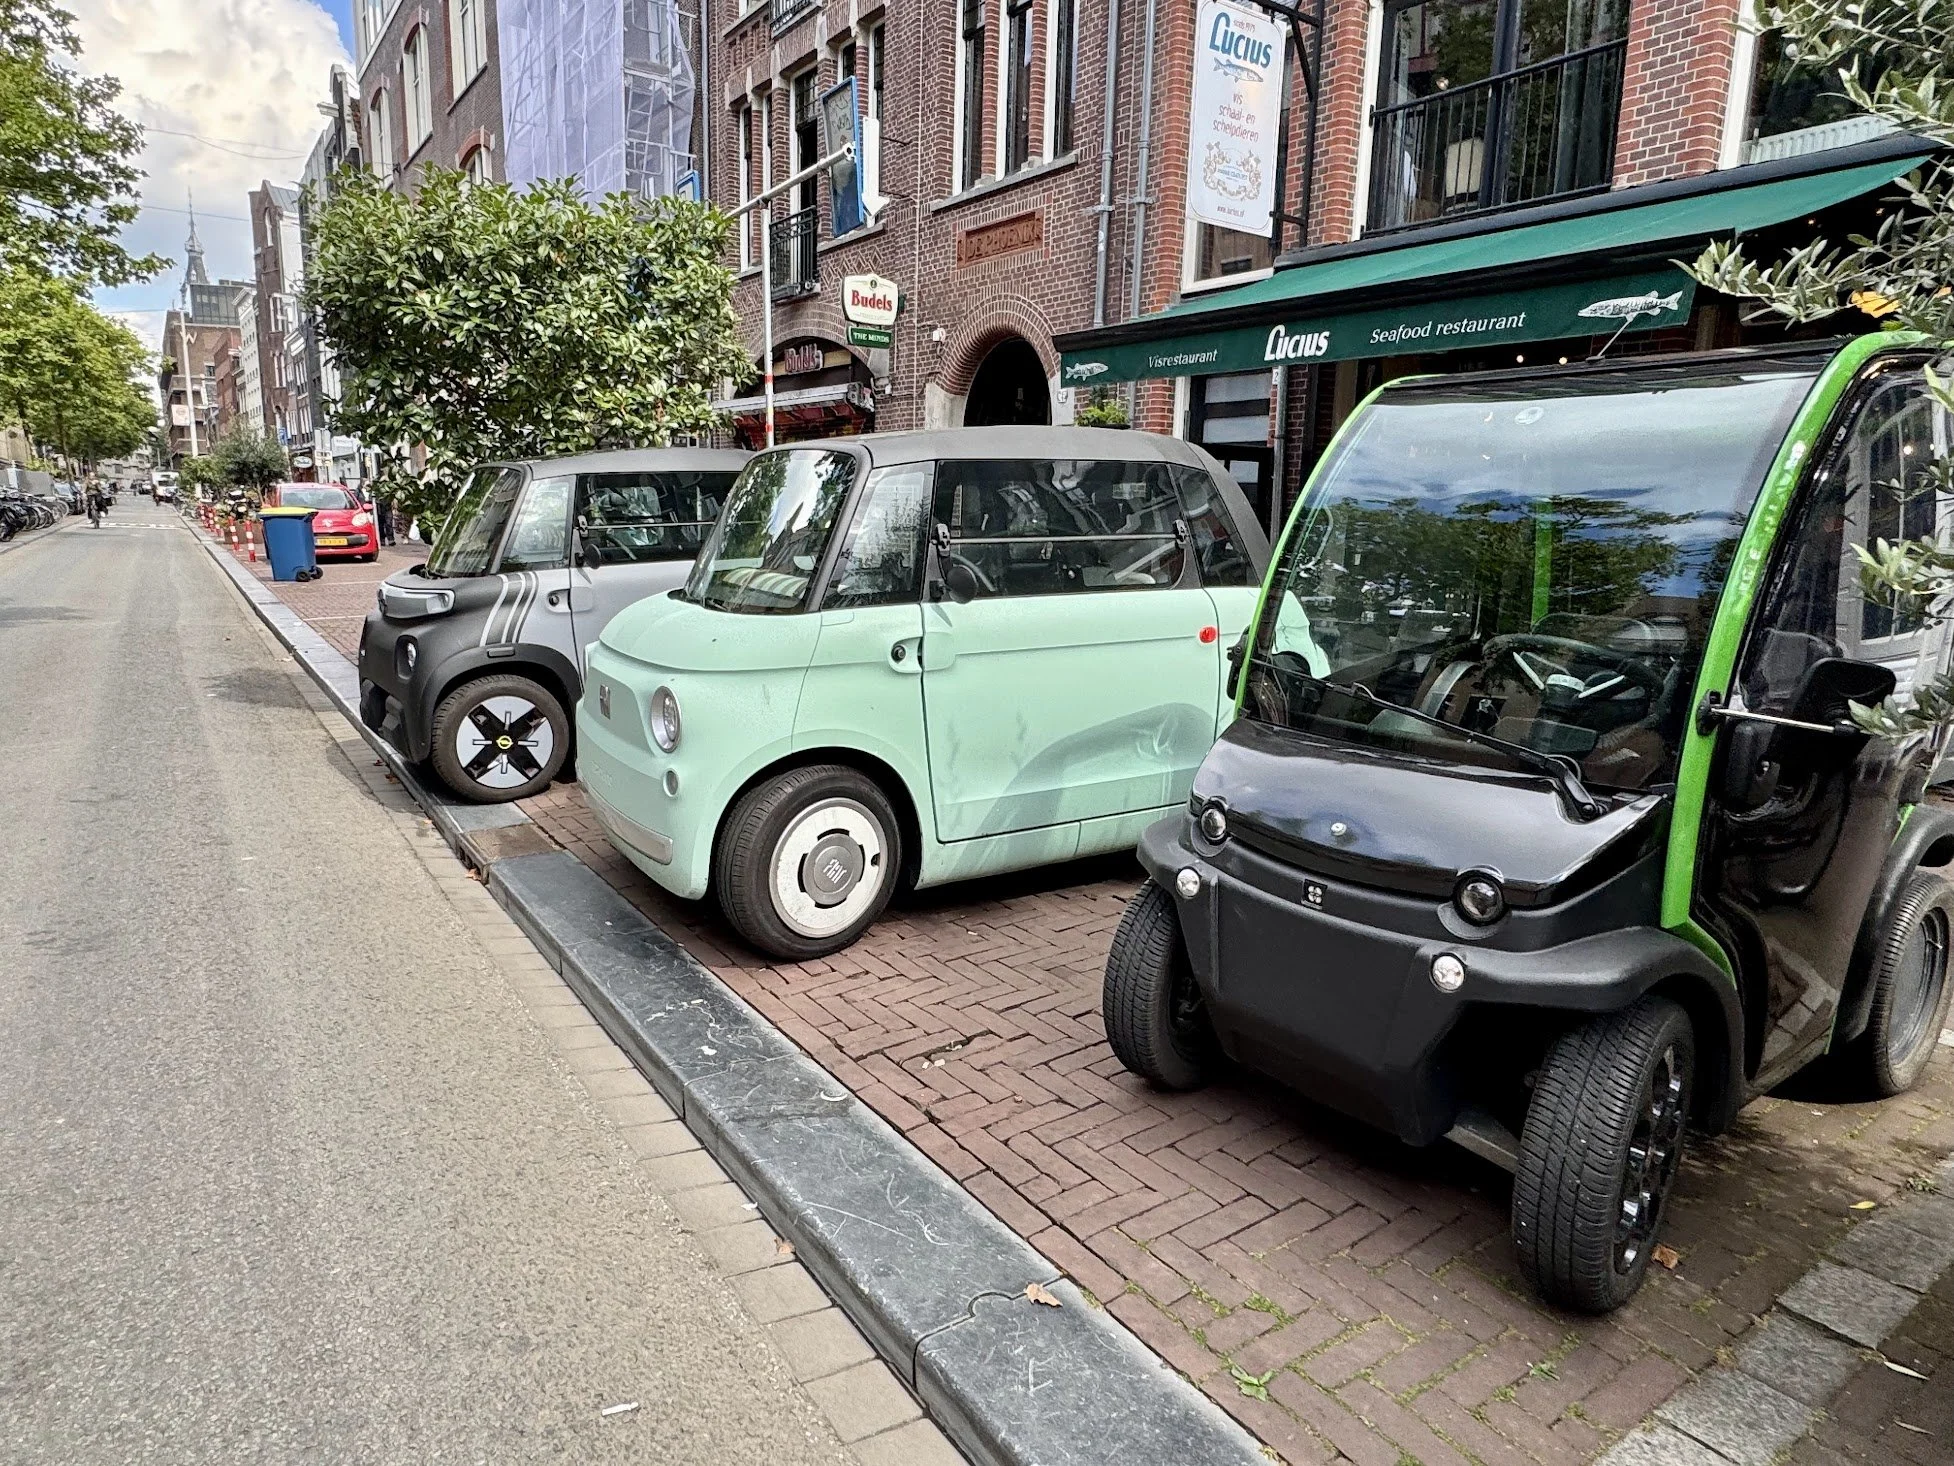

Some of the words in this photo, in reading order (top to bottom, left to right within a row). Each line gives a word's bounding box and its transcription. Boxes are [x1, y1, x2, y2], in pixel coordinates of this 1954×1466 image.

[1209, 11, 1273, 69] Lucius
[1233, 92, 1244, 105] vis
[1212, 118, 1260, 143] schelpdieren
[1245, 113, 1256, 125] en
[851, 289, 893, 312] Budels
[852, 331, 868, 342] THE
[1148, 348, 1218, 368] Visrestaurant
[1263, 324, 1331, 361] Lucius
[1370, 320, 1433, 345] Seafood
[1435, 311, 1527, 336] restaurant
